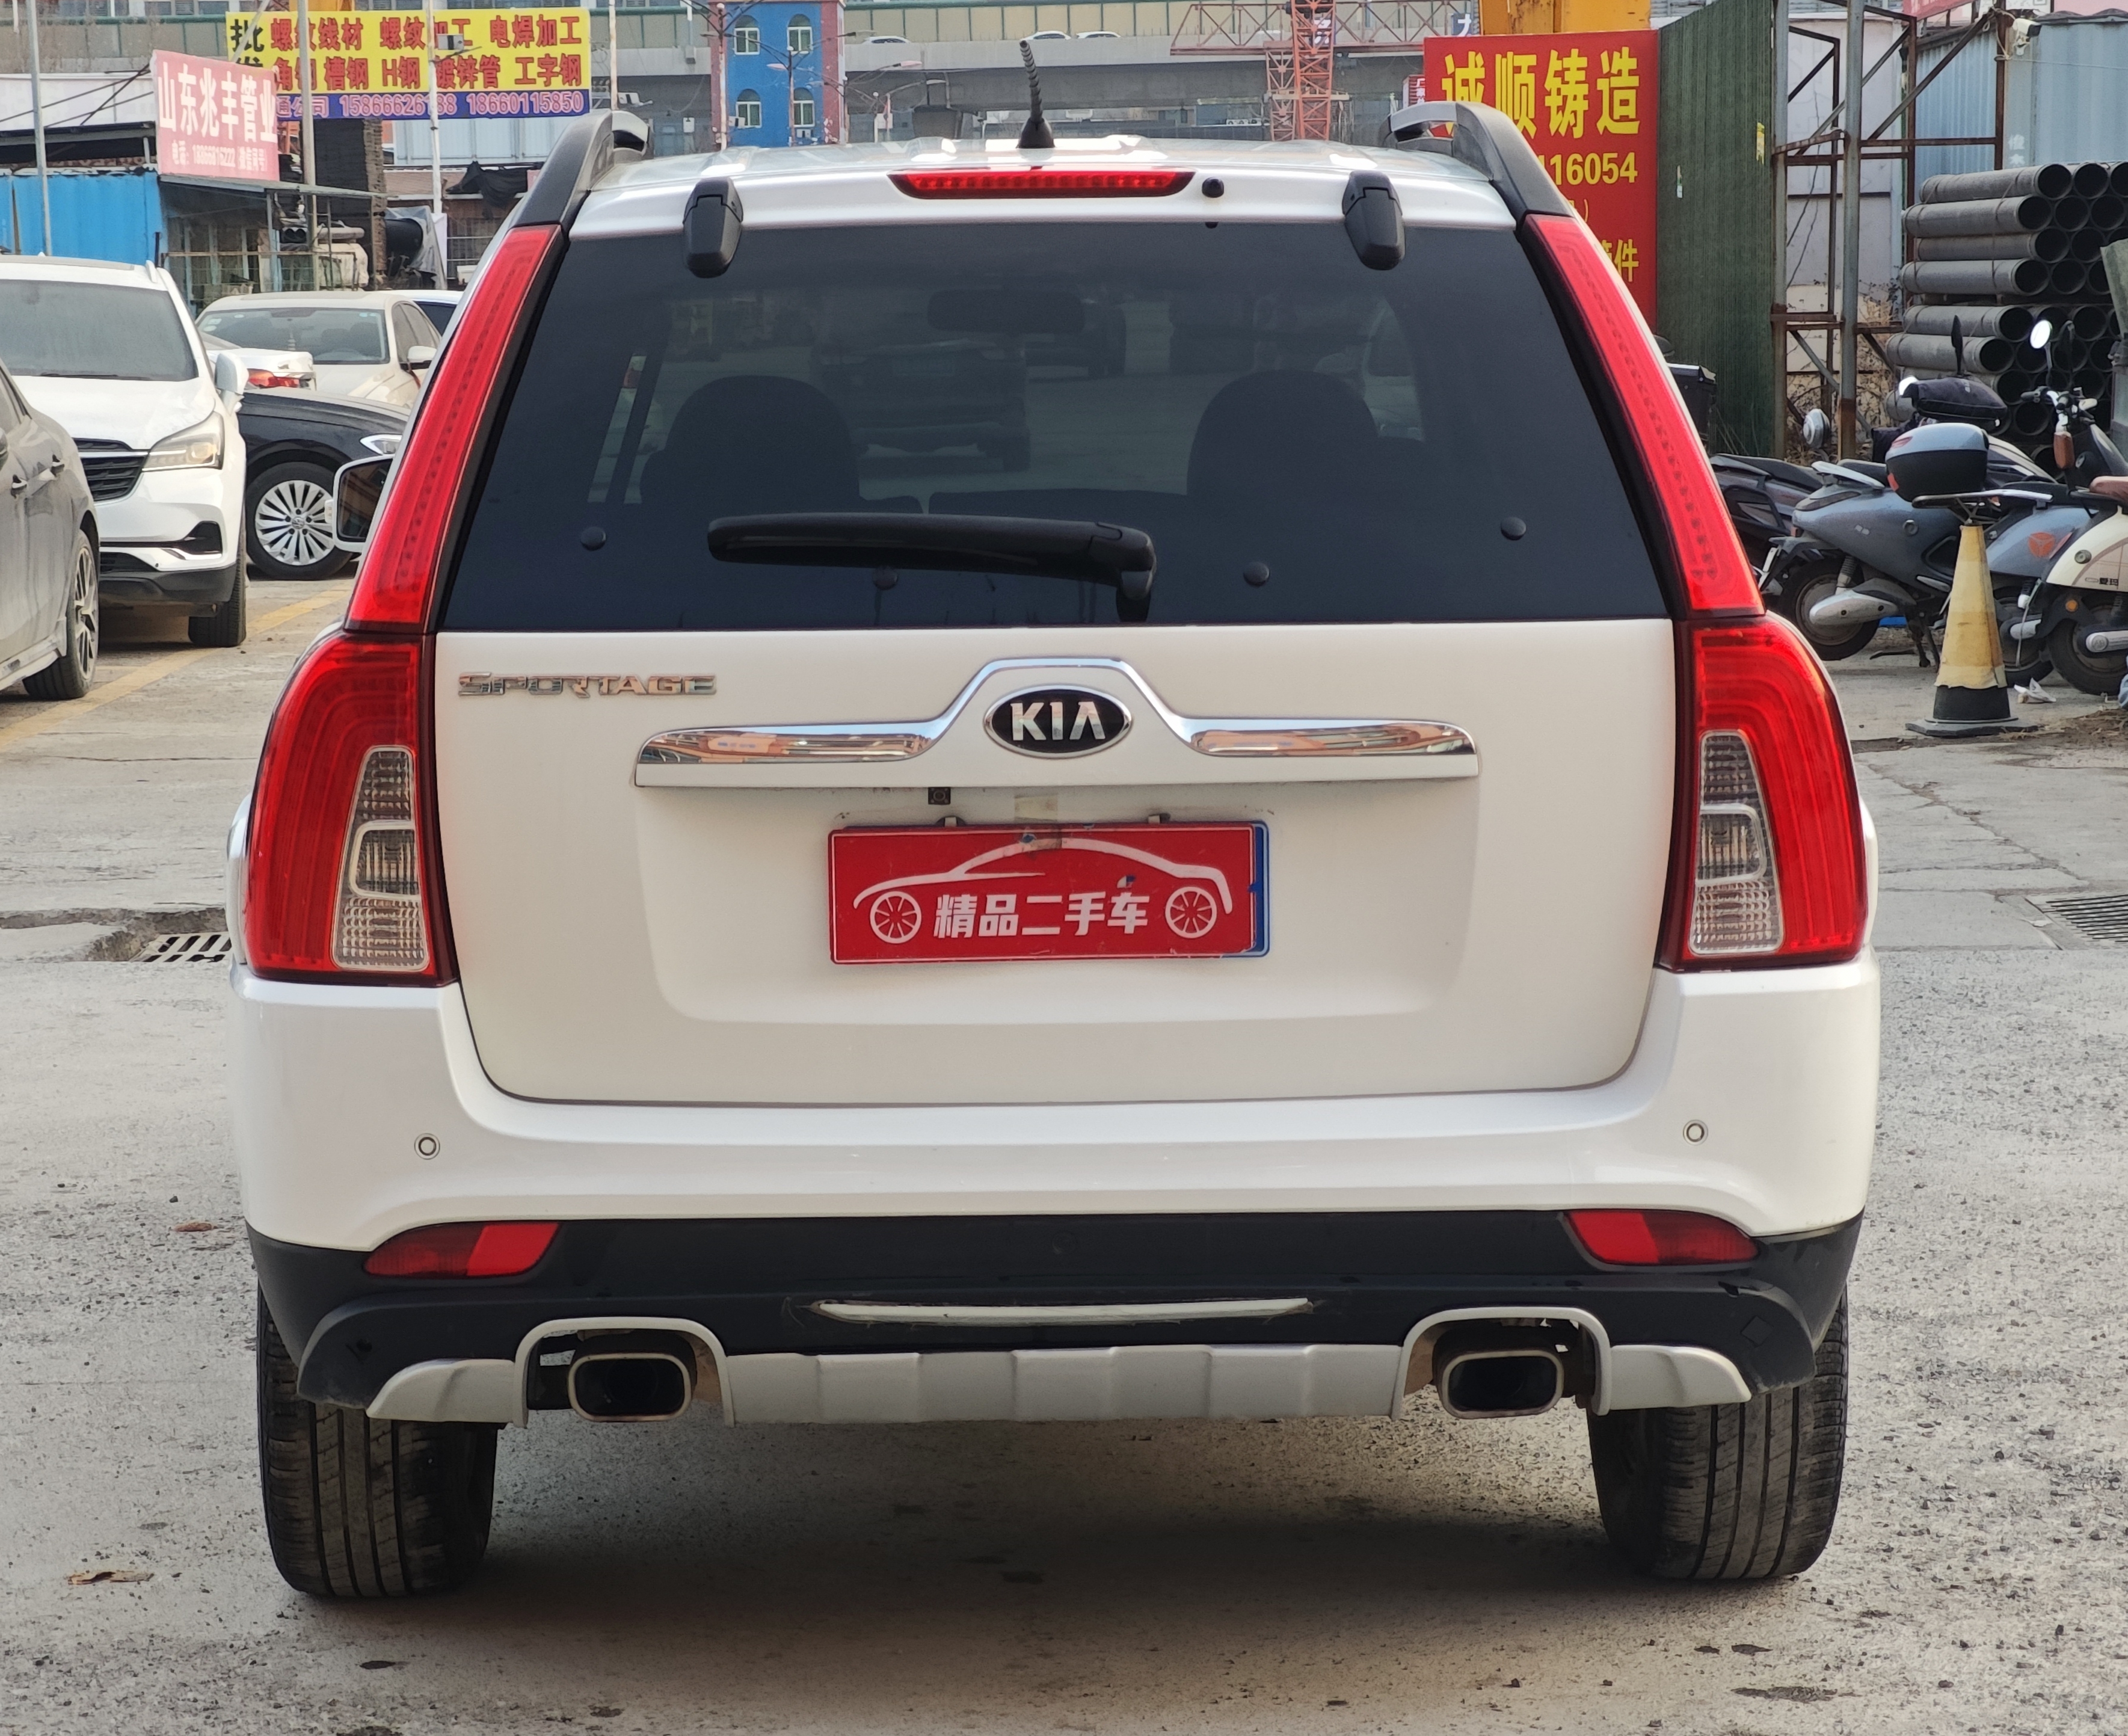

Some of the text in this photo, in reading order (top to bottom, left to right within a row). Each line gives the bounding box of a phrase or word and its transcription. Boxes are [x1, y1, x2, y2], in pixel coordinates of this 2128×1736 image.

[490, 14, 582, 48] 电焊加工
[324, 56, 368, 90] 槽钢
[381, 56, 420, 89] H钢
[434, 55, 500, 89] 镀锌管
[514, 54, 582, 87] 工字钢
[158, 61, 278, 143] 山东兆丰管业
[466, 91, 584, 115] 18660115850
[1442, 46, 1640, 139] 诚顺铸造
[458, 672, 716, 698] SPORTAGE
[1010, 701, 1106, 741] KIA
[933, 892, 1151, 939] 精品二手车
